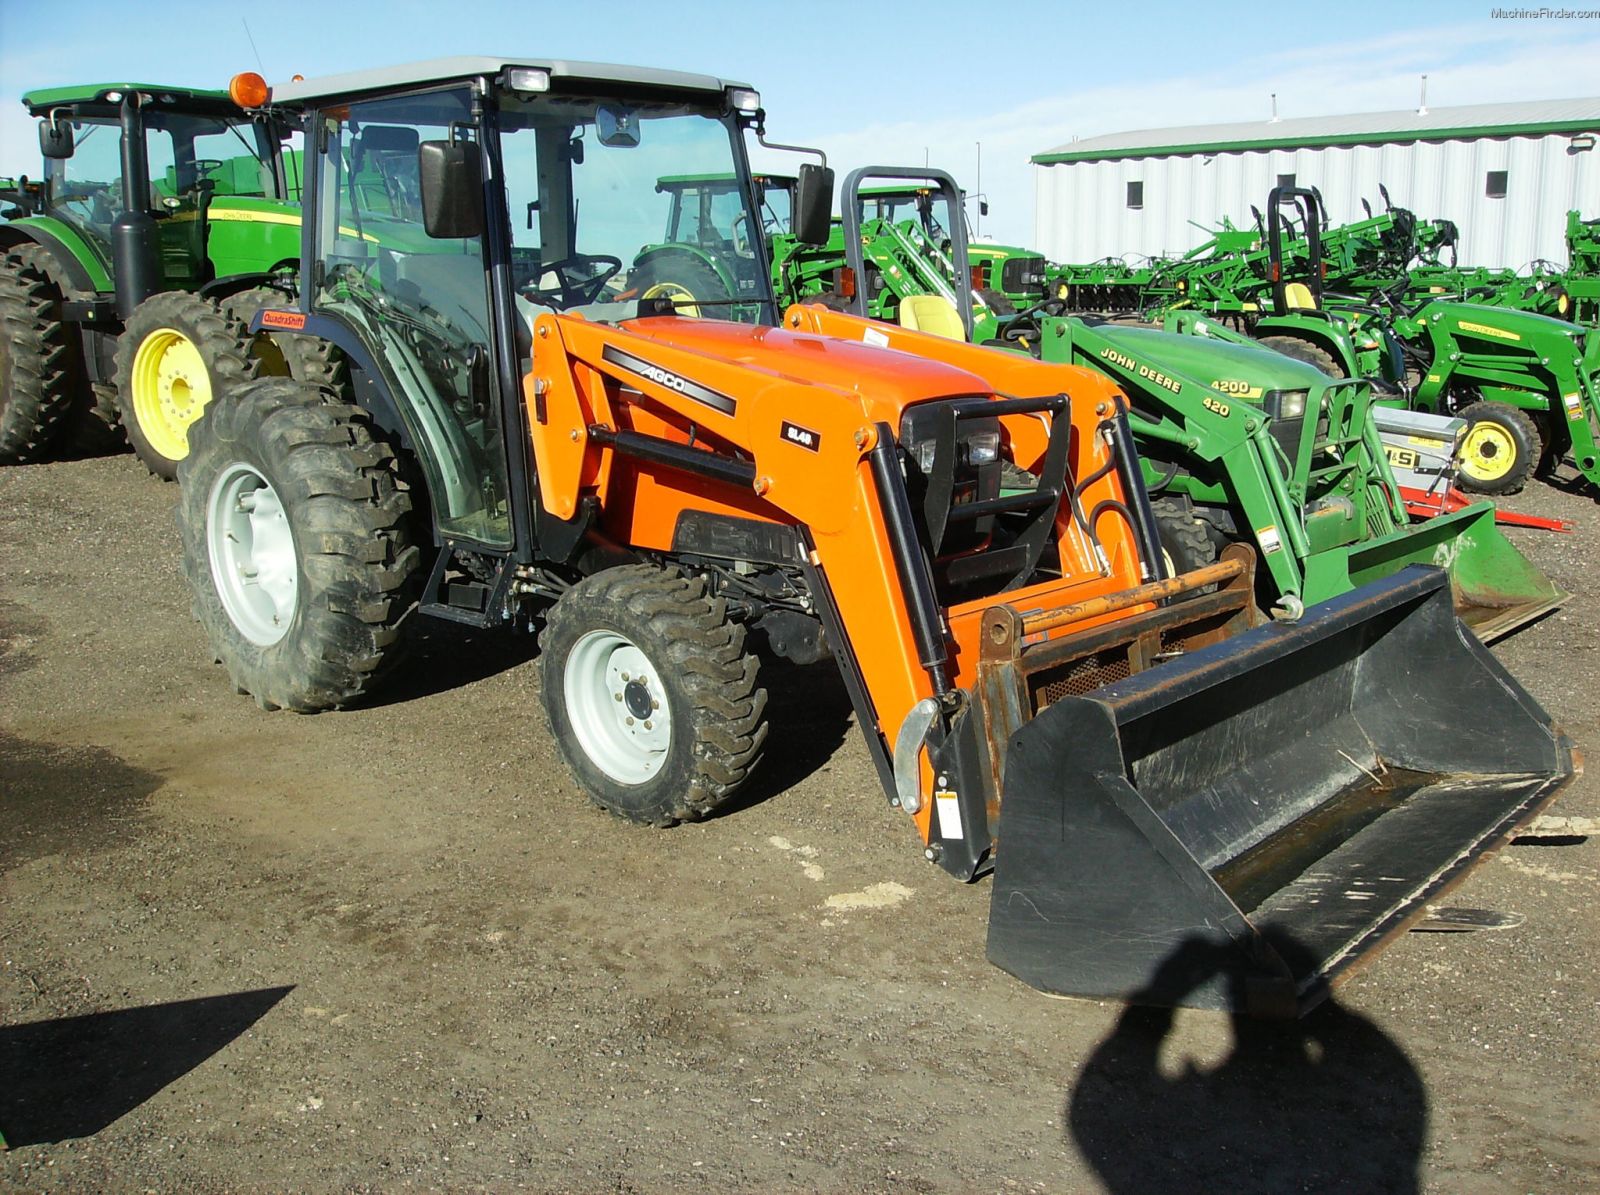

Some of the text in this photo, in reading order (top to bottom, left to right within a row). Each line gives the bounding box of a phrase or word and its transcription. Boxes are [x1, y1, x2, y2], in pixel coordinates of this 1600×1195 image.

[263, 313, 304, 327] QuadraShift
[640, 366, 686, 392] AGCO
[1100, 348, 1182, 394] JOHN DEERE
[1210, 380, 1251, 393] 4200
[1202, 397, 1230, 418] 420
